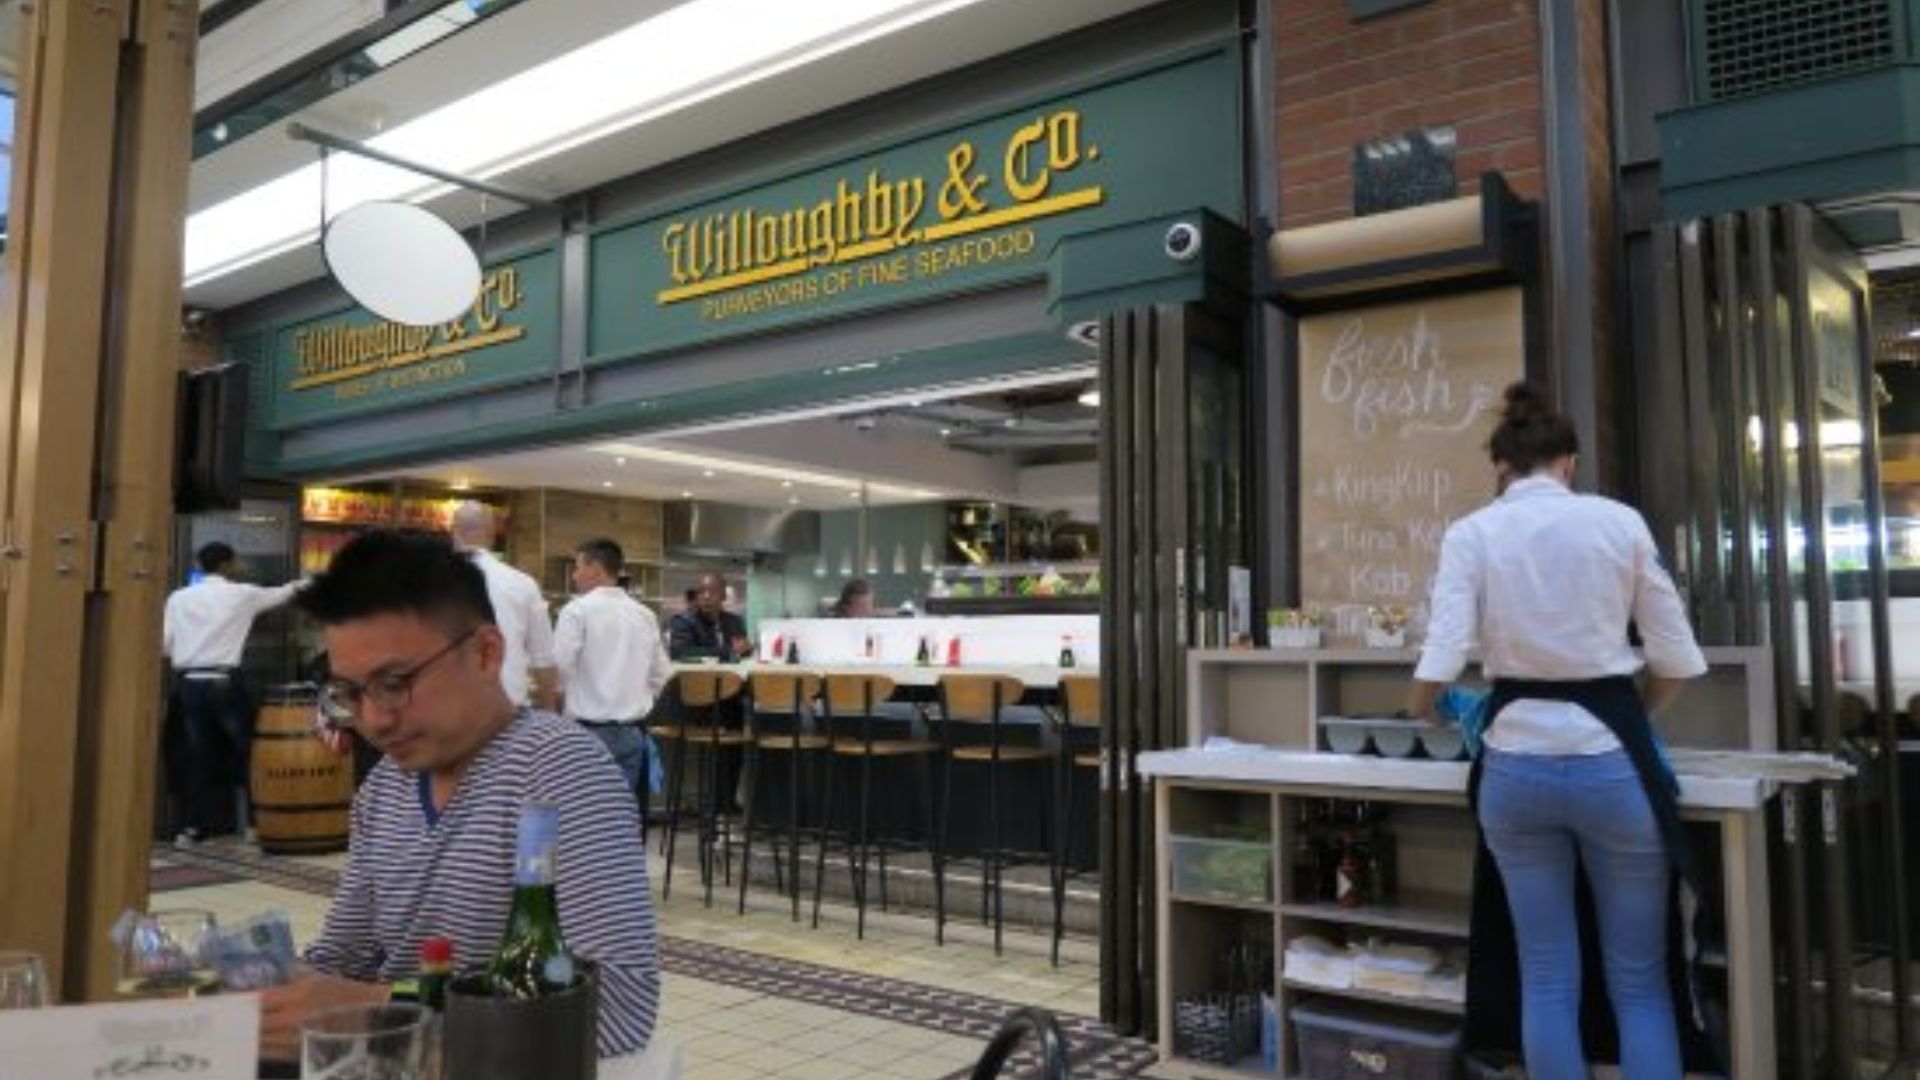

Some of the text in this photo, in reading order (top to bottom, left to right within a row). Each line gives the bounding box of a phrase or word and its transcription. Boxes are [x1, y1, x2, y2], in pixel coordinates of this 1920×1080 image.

[662, 109, 1099, 284] Willoughby & Co.
[702, 228, 1036, 320] PURVEYORS OF FINE SEAFOOD
[1322, 312, 1446, 403] fresh
[1353, 368, 1455, 440] fish
